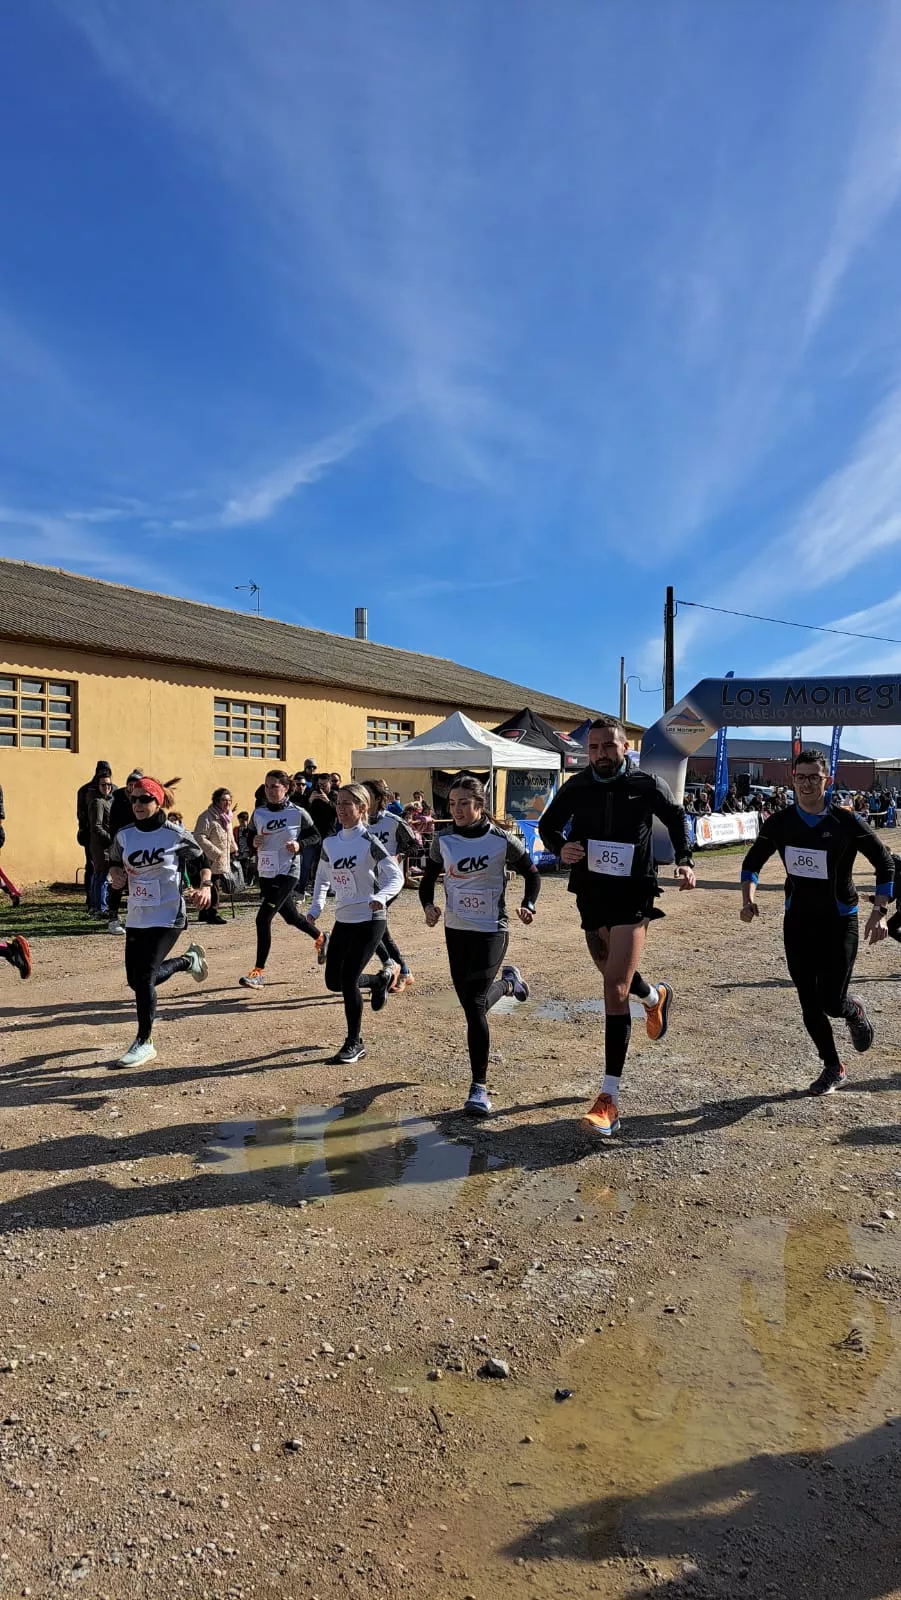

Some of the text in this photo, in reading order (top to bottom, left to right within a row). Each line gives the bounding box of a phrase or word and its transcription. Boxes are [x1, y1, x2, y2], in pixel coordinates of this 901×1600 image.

[722, 683, 772, 707] Los
[722, 706, 877, 721] CONSEJO COMARCAL
[267, 818, 287, 830] CNS
[375, 830, 390, 844] NS
[128, 847, 166, 868] CNS
[333, 855, 357, 870] CNS
[457, 855, 489, 872] CNS
[601, 850, 619, 864] 85
[797, 855, 814, 867] 86
[336, 875, 347, 886] 46
[135, 886, 148, 897] 84
[464, 897, 480, 909] 33
